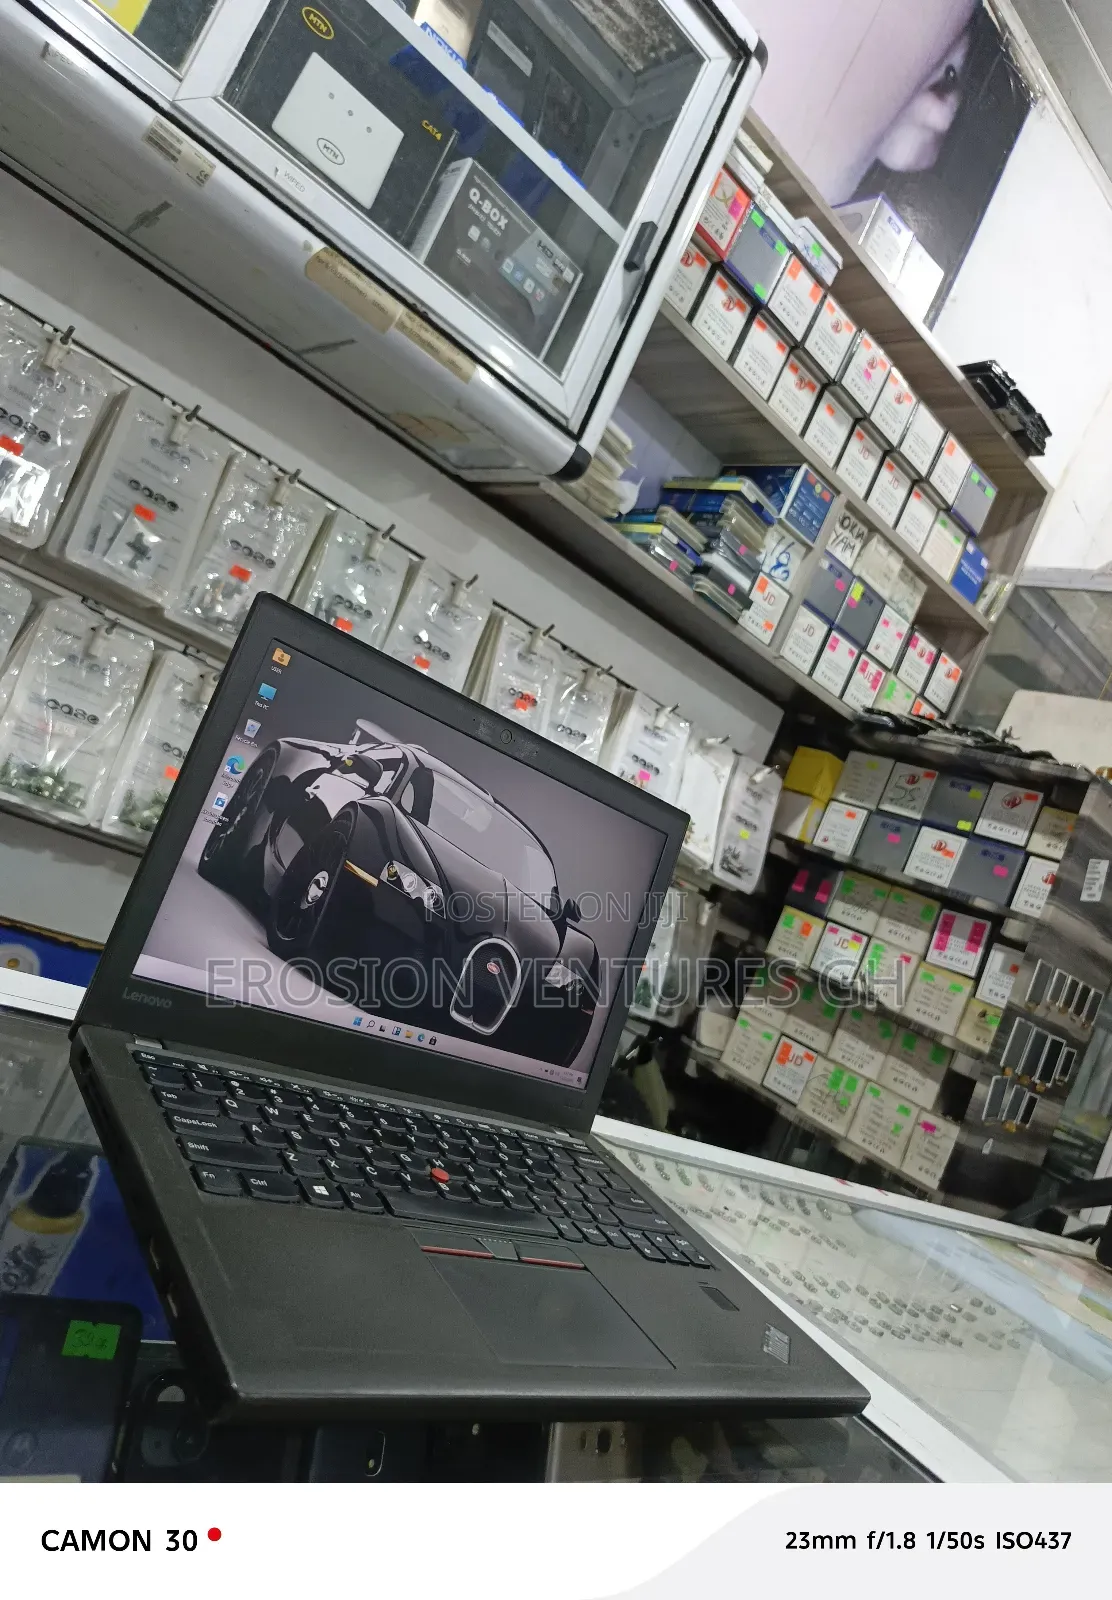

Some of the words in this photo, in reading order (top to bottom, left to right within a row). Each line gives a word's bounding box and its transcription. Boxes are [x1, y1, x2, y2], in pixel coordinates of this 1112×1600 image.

[308, 13, 329, 34] MTN
[421, 119, 442, 141] CAT4
[322, 143, 339, 160] MTN
[469, 187, 509, 231] Q-BOX
[762, 592, 776, 606] JD
[802, 623, 816, 638] JD
[45, 698, 100, 725] case
[122, 986, 173, 1009] Lenovo
[161, 1091, 178, 1099] Tab
[225, 1098, 238, 1109] Q
[264, 1105, 279, 1116] W
[173, 1115, 218, 1128] CapsLock
[303, 1113, 314, 1123] E
[251, 1124, 263, 1134] A
[339, 1121, 351, 1131] R
[291, 1130, 302, 1140] S
[373, 1128, 382, 1137] T
[328, 1138, 340, 1147] D
[406, 1134, 416, 1144] Y
[187, 1141, 210, 1151] Shift
[365, 1146, 374, 1154] F
[438, 1140, 449, 1150] U
[286, 1152, 299, 1162] Z
[400, 1153, 412, 1162] G
[327, 1158, 340, 1169] X
[432, 1158, 445, 1168] H
[202, 1171, 216, 1180] Fn
[366, 1166, 378, 1176] C
[495, 1169, 508, 1178] K
[400, 1172, 412, 1182] V
[250, 1178, 268, 1187] Ctrl
[468, 1182, 482, 1193] N
[500, 1187, 514, 1198] M
